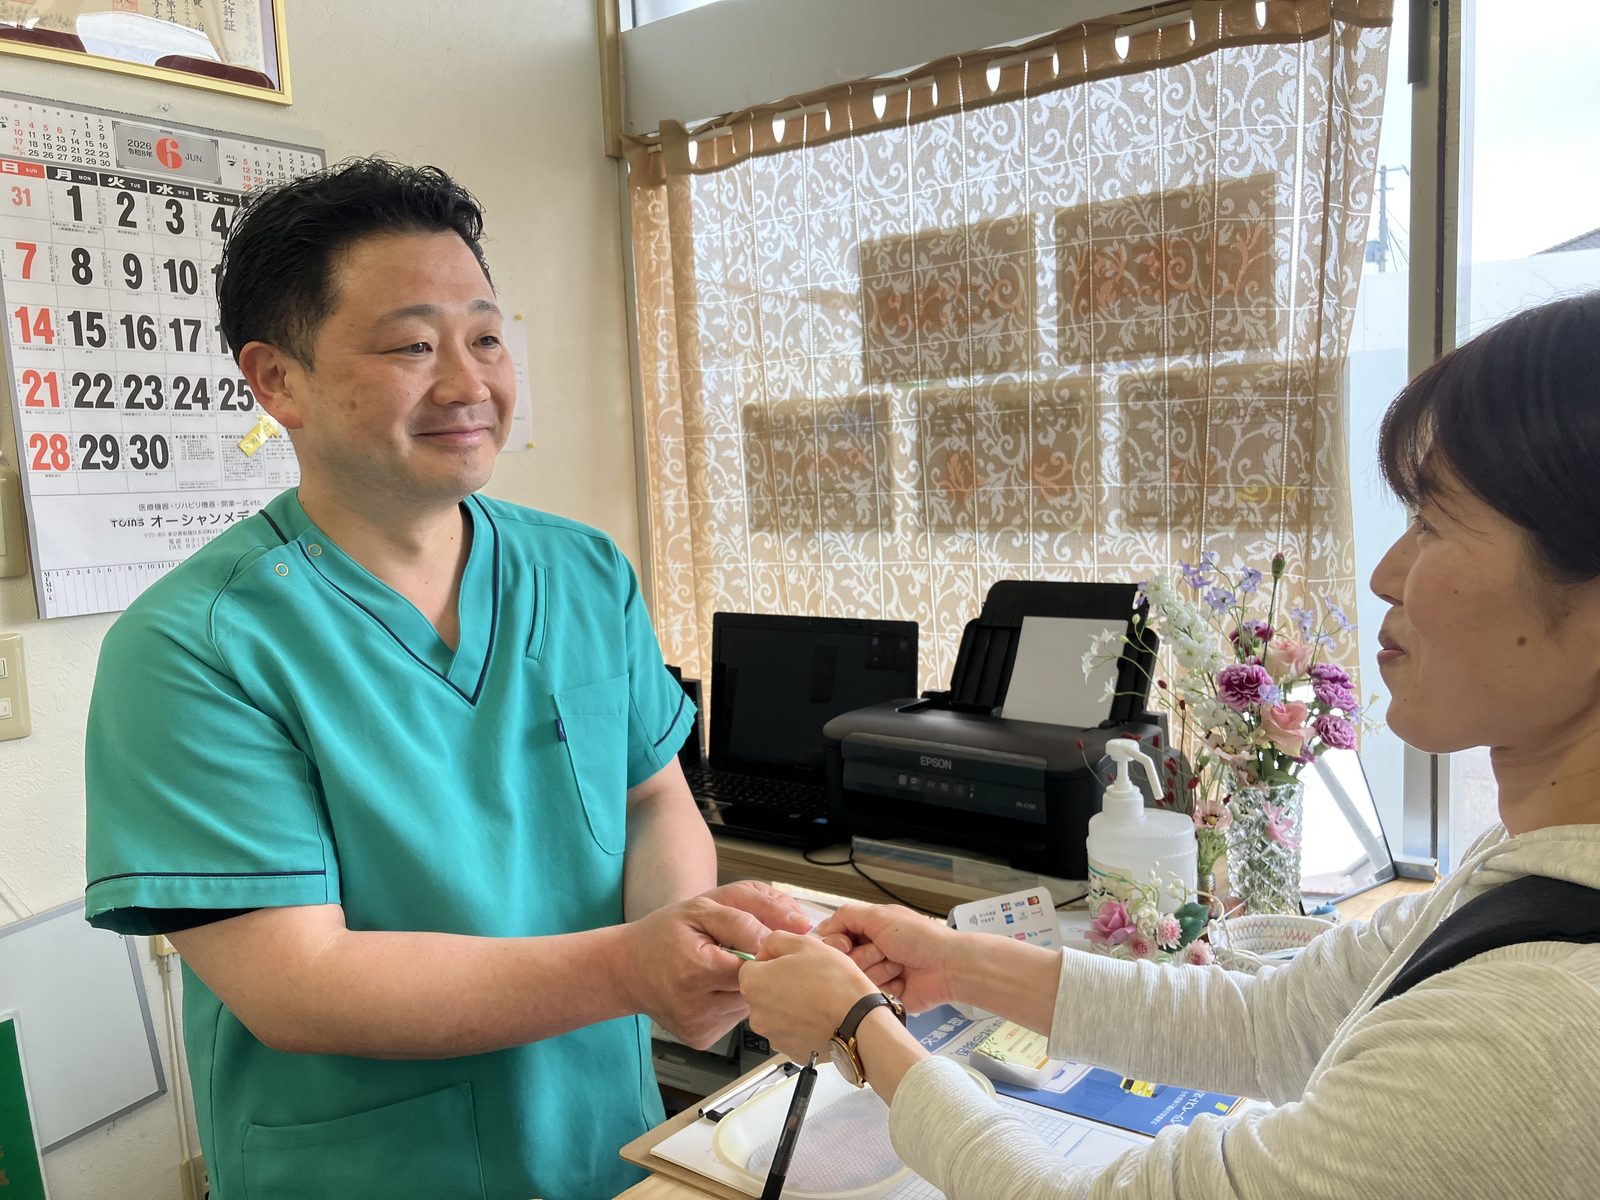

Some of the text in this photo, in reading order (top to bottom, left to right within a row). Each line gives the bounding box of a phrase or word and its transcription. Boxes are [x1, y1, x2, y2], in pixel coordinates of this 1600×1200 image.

[127, 139, 152, 150] 2026
[128, 148, 152, 158] 令和8年
[156, 138, 182, 169] 6
[185, 153, 205, 163] JUN.
[2, 161, 18, 173] 日
[55, 169, 72, 180] 月
[108, 177, 126, 188] 火
[156, 184, 174, 195] 水
[203, 192, 219, 202] 木
[11, 186, 230, 240] 31 1 2 3 4
[16, 242, 36, 279] 7
[71, 248, 93, 285] 8
[123, 253, 142, 289] 9
[163, 259, 198, 295] 10
[15, 306, 55, 345] 14
[67, 310, 106, 348] 15
[120, 314, 157, 351] 16
[168, 318, 201, 352] 17
[22, 369, 254, 412] 21 22 23 24 25
[30, 433, 70, 471] 28
[79, 434, 120, 470] 29
[129, 434, 169, 470] 30
[150, 510, 250, 528] オーシャンメデ
[920, 755, 952, 771] EPSON
